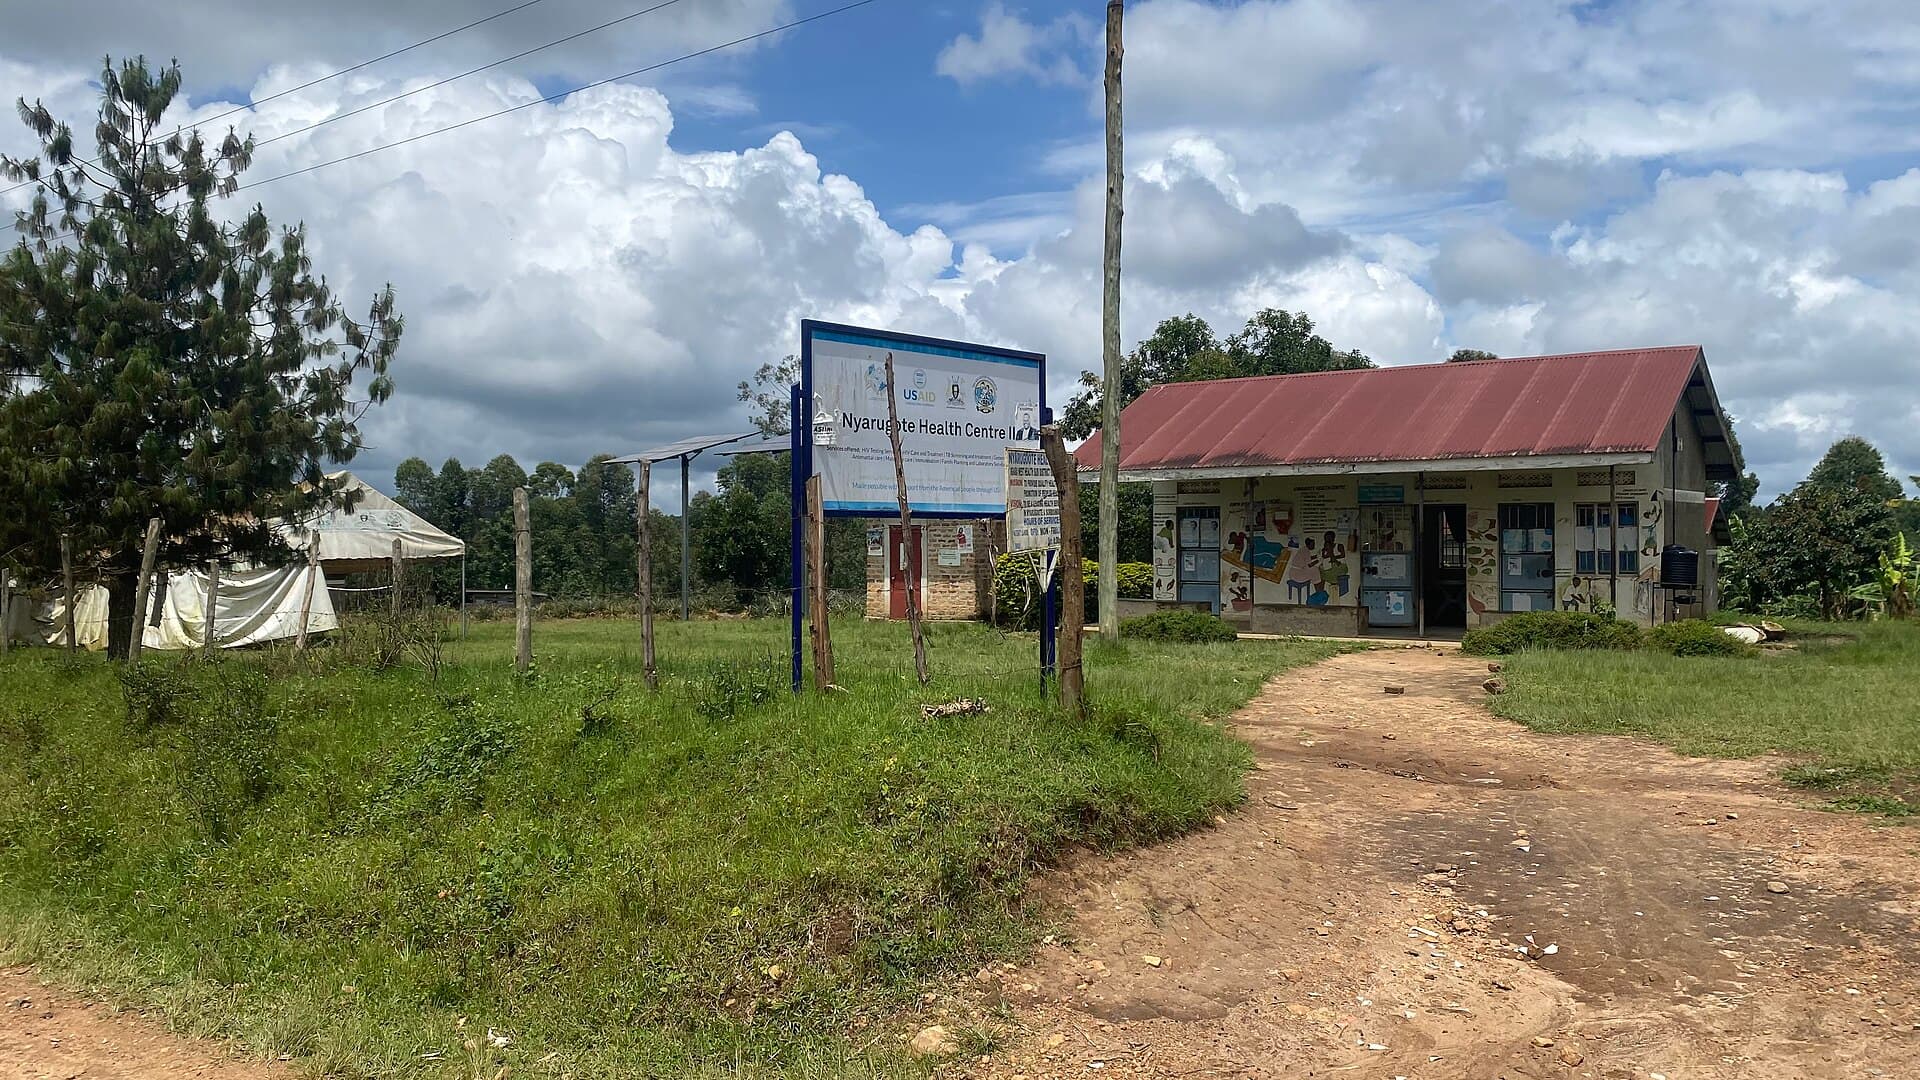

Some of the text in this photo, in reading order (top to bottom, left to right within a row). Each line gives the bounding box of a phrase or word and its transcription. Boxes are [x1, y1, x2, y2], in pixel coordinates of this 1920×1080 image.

[903, 388, 936, 403] USAID
[842, 412, 1016, 440] Nyarugote Health Centre II
